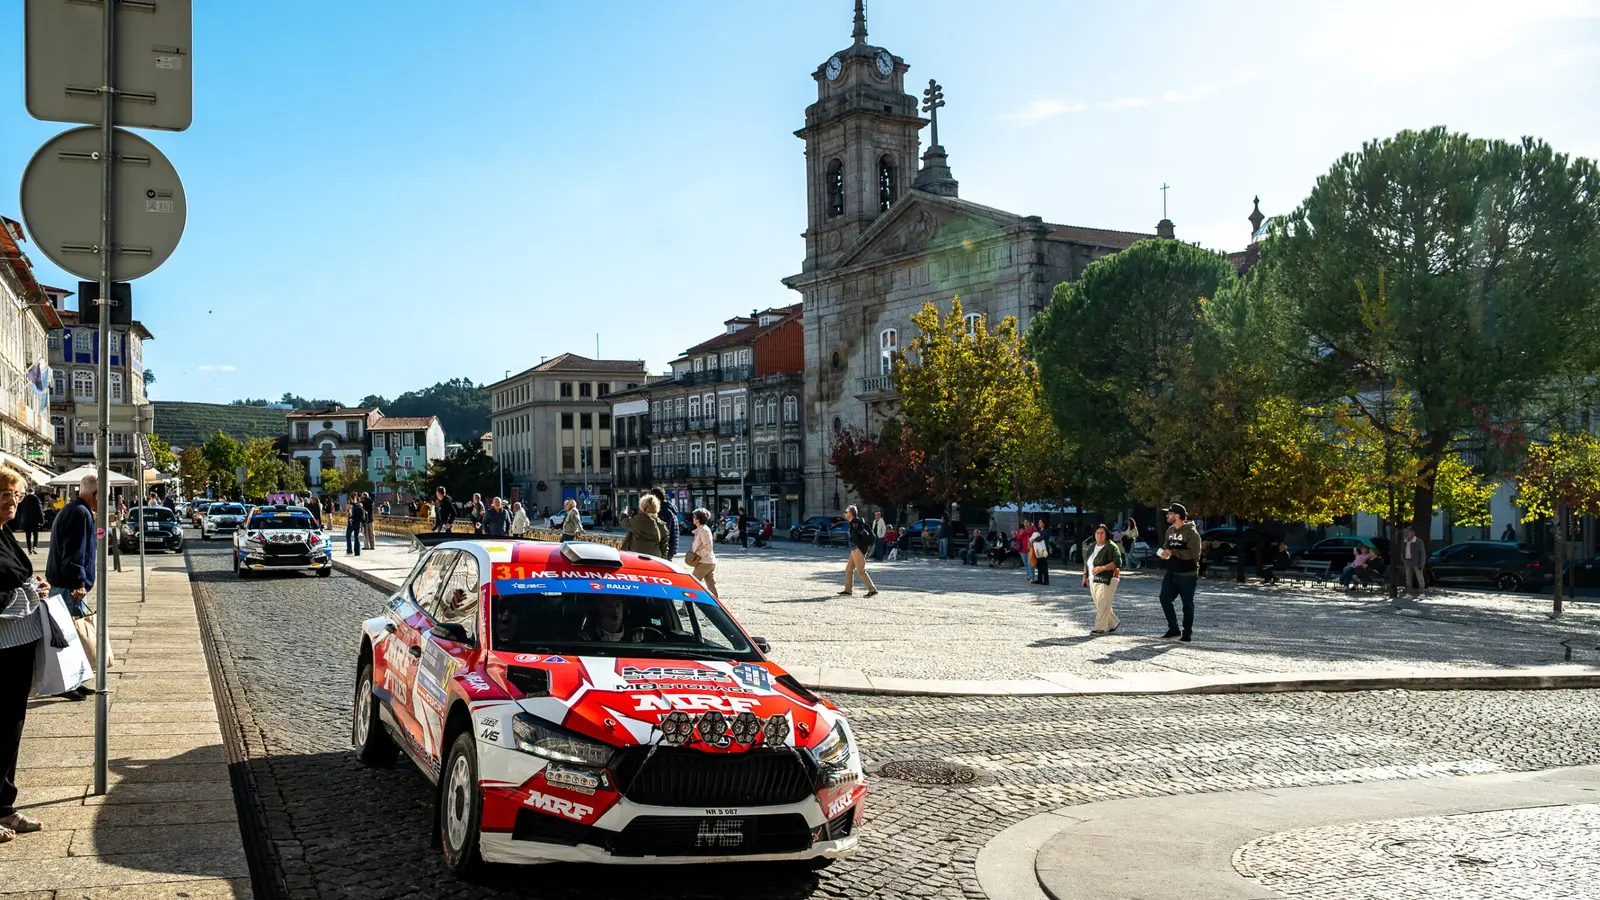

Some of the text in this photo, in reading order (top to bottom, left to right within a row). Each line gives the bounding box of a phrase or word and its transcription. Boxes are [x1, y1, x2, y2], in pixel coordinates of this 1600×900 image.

[497, 566, 525, 580] 31
[561, 571, 673, 585] MUNARETTO
[631, 694, 761, 712] MRF
[524, 789, 594, 820] MRF
[828, 787, 853, 818] MRF
[695, 820, 744, 846] MS
